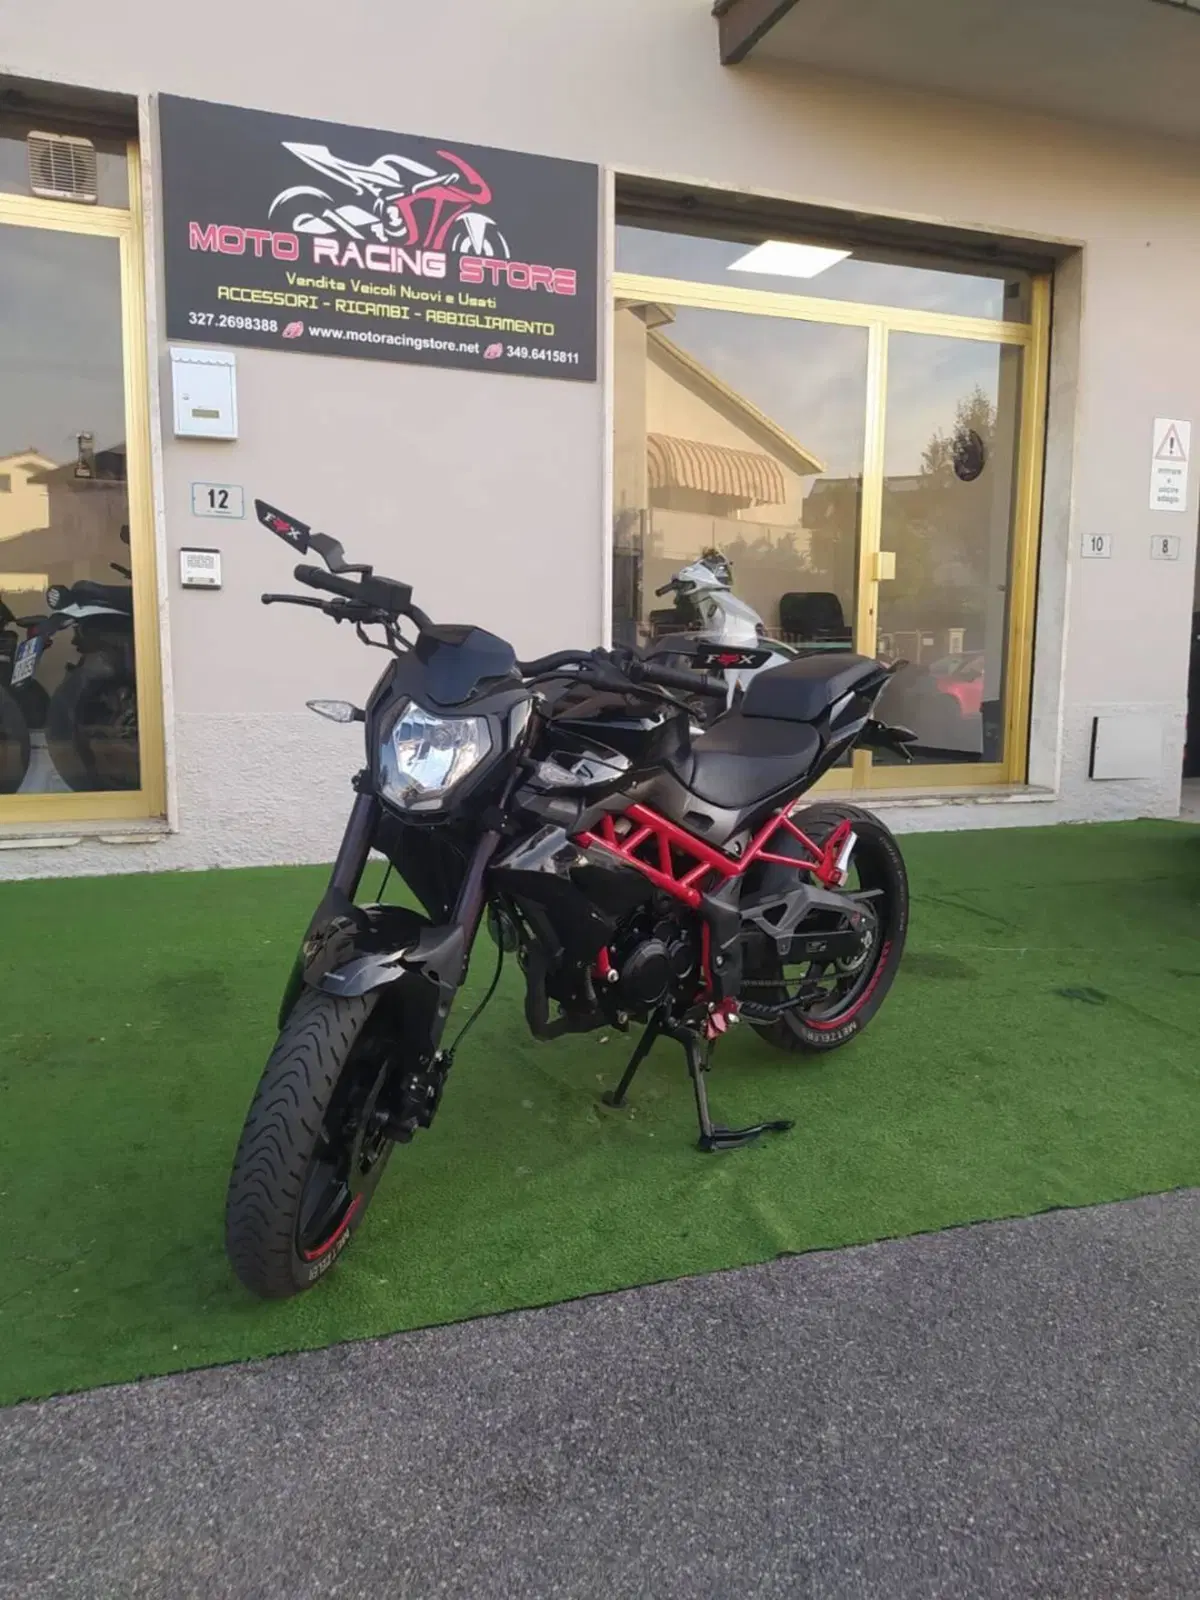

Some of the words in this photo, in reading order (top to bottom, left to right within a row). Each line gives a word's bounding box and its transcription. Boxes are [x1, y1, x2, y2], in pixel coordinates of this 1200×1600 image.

[189, 221, 300, 261] MOTO
[313, 237, 447, 279] RACING
[459, 255, 577, 296] STORE
[285, 271, 346, 291] Vendita
[351, 279, 397, 297] Veicoli
[400, 285, 442, 302] Nuovi
[445, 294, 454, 304] e
[458, 292, 497, 309] Usati
[217, 285, 319, 310] ACCESSORI
[335, 299, 410, 320] RICAMBI
[426, 309, 555, 336] ABBIGLIAMENTO
[188, 312, 278, 333] 327.2698388
[308, 324, 480, 355] www.motoracingstore.net
[507, 345, 579, 364] 349.6415811
[208, 488, 229, 509] 12
[1091, 536, 1104, 552] 10
[1161, 538, 1169, 554] 8
